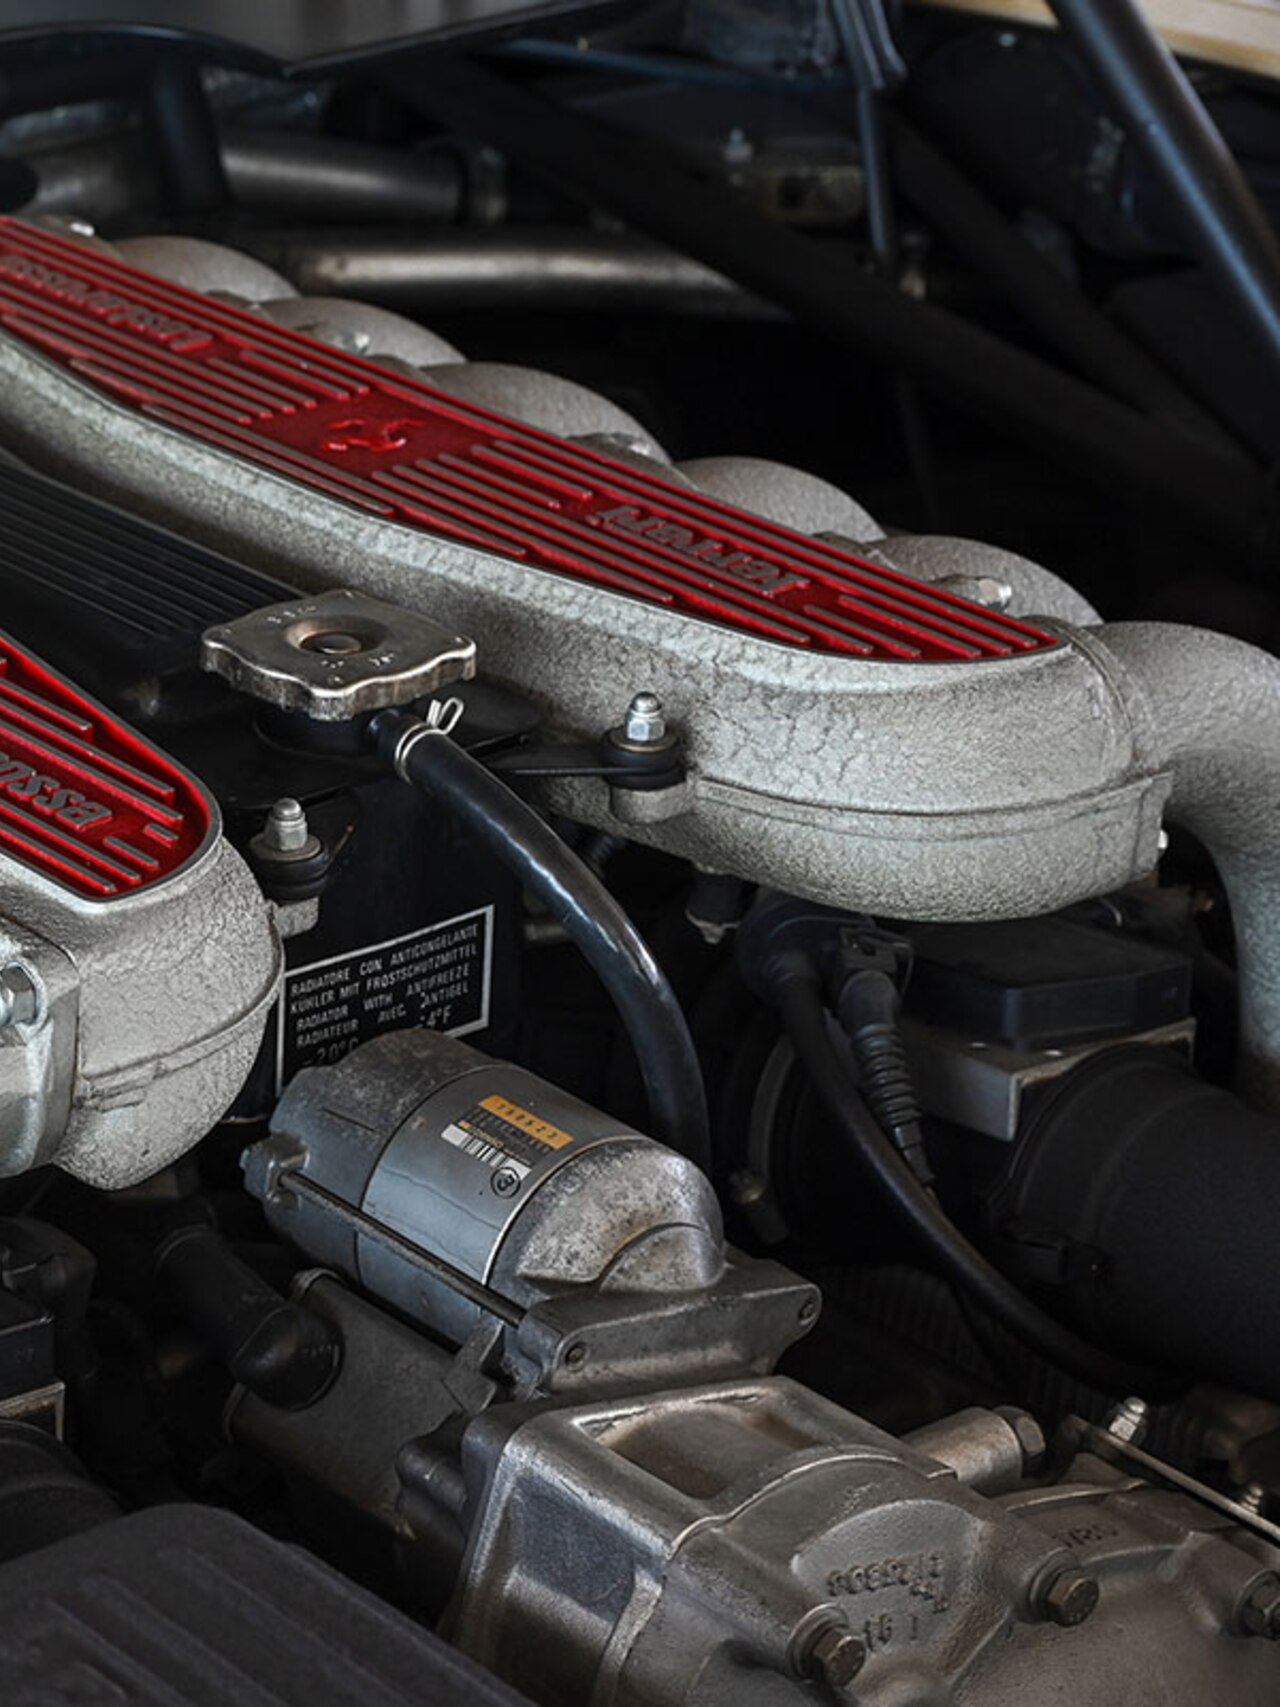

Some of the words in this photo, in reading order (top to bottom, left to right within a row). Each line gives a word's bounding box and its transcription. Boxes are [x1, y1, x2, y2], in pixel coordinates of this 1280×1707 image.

[291, 967, 351, 998] RADIATORE
[360, 957, 383, 976] CON
[390, 922, 478, 967] ANTICONGELANTE
[339, 981, 360, 1001] MIT
[366, 943, 477, 991] FROSTSCHUTZMITTEL
[296, 1003, 349, 1032] RADIATOR
[363, 992, 392, 1012] WITH
[405, 962, 470, 998] ANTIFREEZE
[296, 1018, 359, 1050] RADIATEUR
[377, 1003, 407, 1024] AVEC
[424, 980, 469, 1006] ANTIGEL
